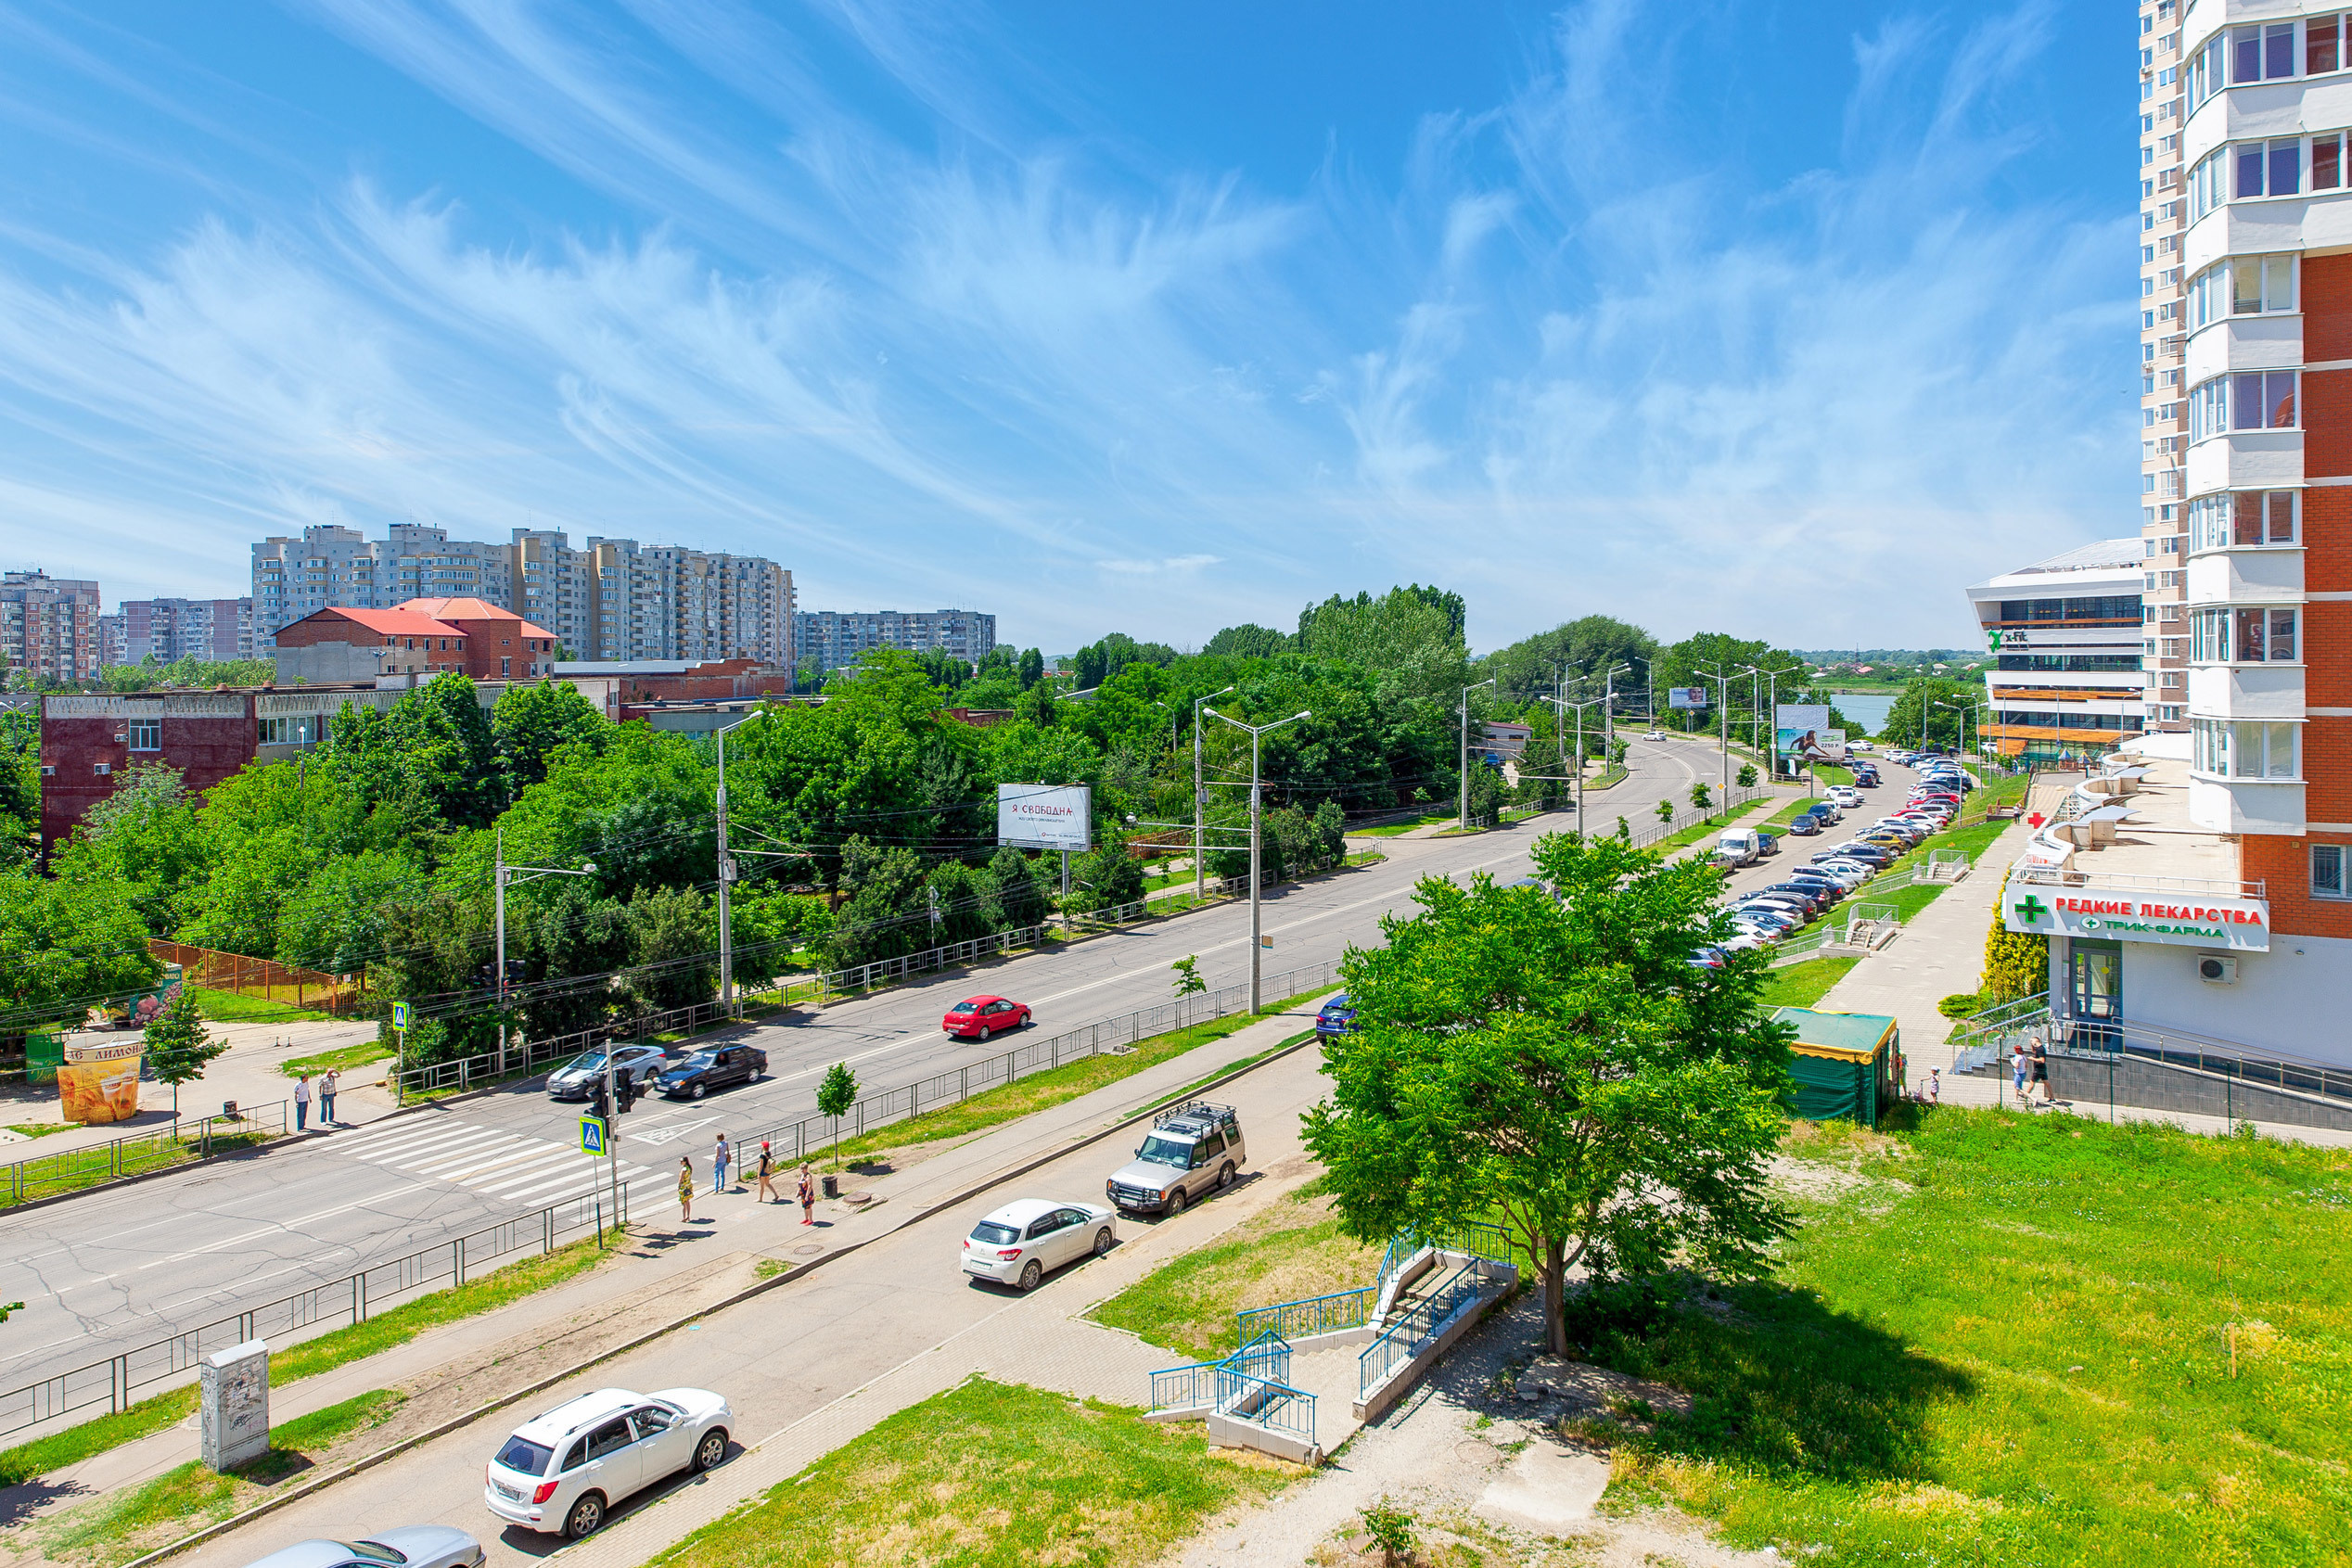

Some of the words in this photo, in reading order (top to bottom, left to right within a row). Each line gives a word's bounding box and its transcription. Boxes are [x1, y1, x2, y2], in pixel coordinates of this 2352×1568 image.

[1012, 804, 1017, 812] Я
[1022, 804, 1073, 816] СВОБОДНА
[2055, 897, 2132, 916] РЕДКИЕ
[2139, 903, 2262, 925] ЛЕКАРСТВА
[2103, 919, 2225, 938] ТРИК-ФАРМА
